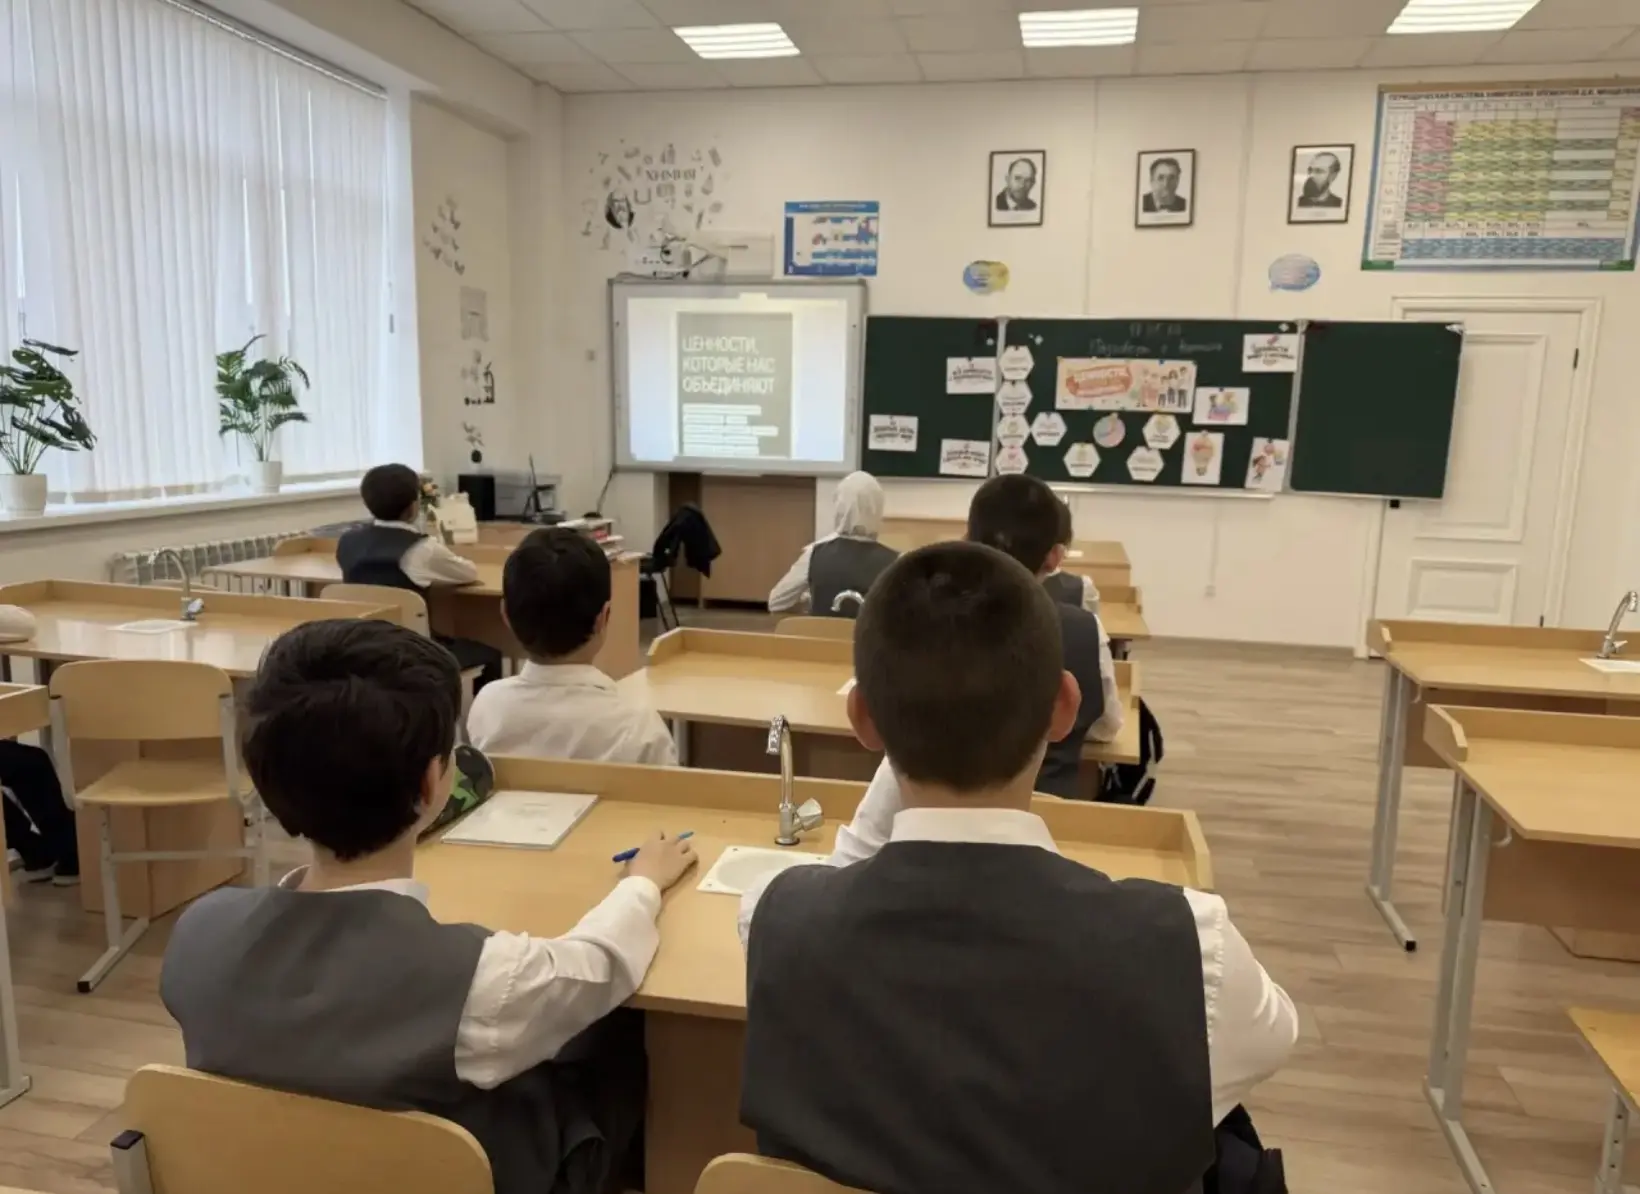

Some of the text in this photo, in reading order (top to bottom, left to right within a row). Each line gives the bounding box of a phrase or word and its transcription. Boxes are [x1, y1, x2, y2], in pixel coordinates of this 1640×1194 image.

[682, 336, 759, 354] ЦЕННОСТИ,
[682, 356, 776, 374] КОТОРЫЕ НАС
[682, 376, 775, 395] ОБЪЕДИНЯЮТ
